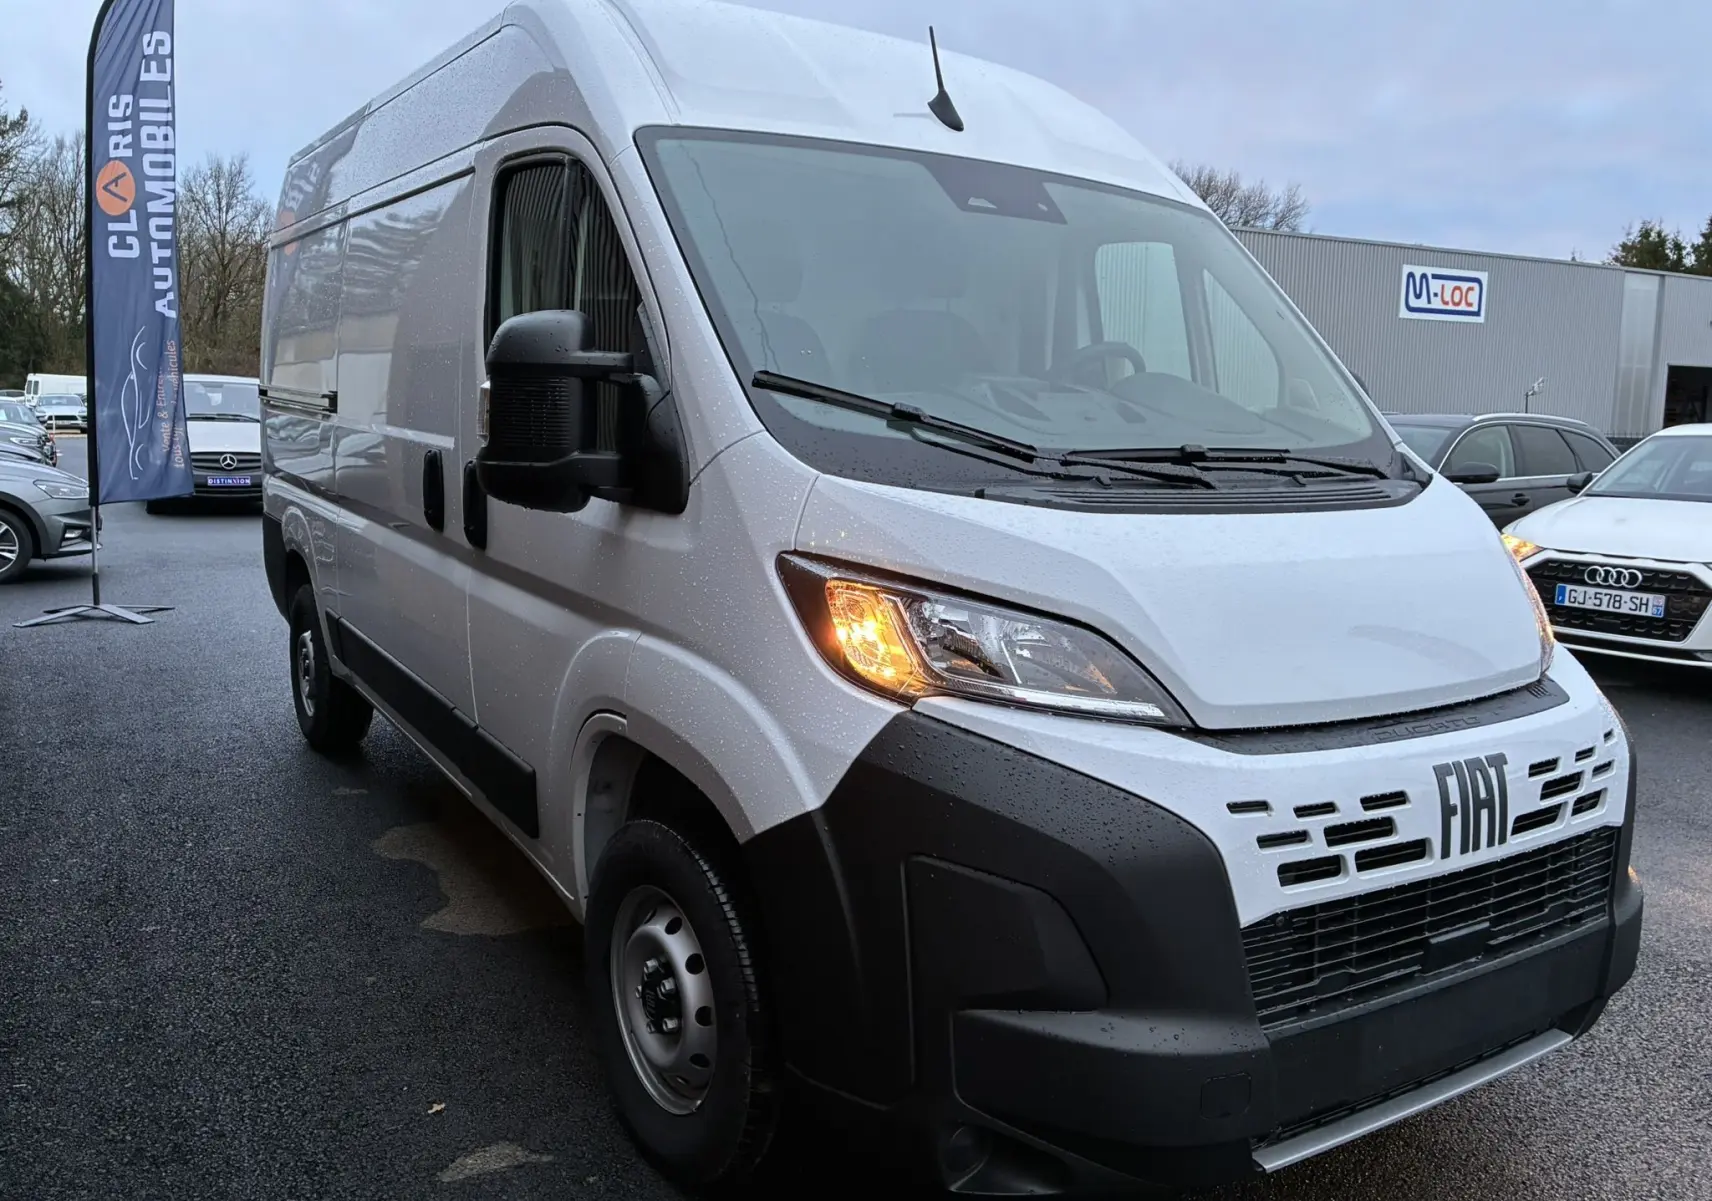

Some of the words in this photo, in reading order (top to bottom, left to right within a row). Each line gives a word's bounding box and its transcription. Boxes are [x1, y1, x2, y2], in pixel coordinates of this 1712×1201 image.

[101, 93, 140, 259] CLARIS
[138, 30, 177, 319] AUTOMOBILES
[1405, 271, 1475, 308] M-LOC
[156, 411, 169, 419] &
[1568, 589, 1649, 613] GJ-578-SH
[1432, 752, 1509, 860] FIAT
